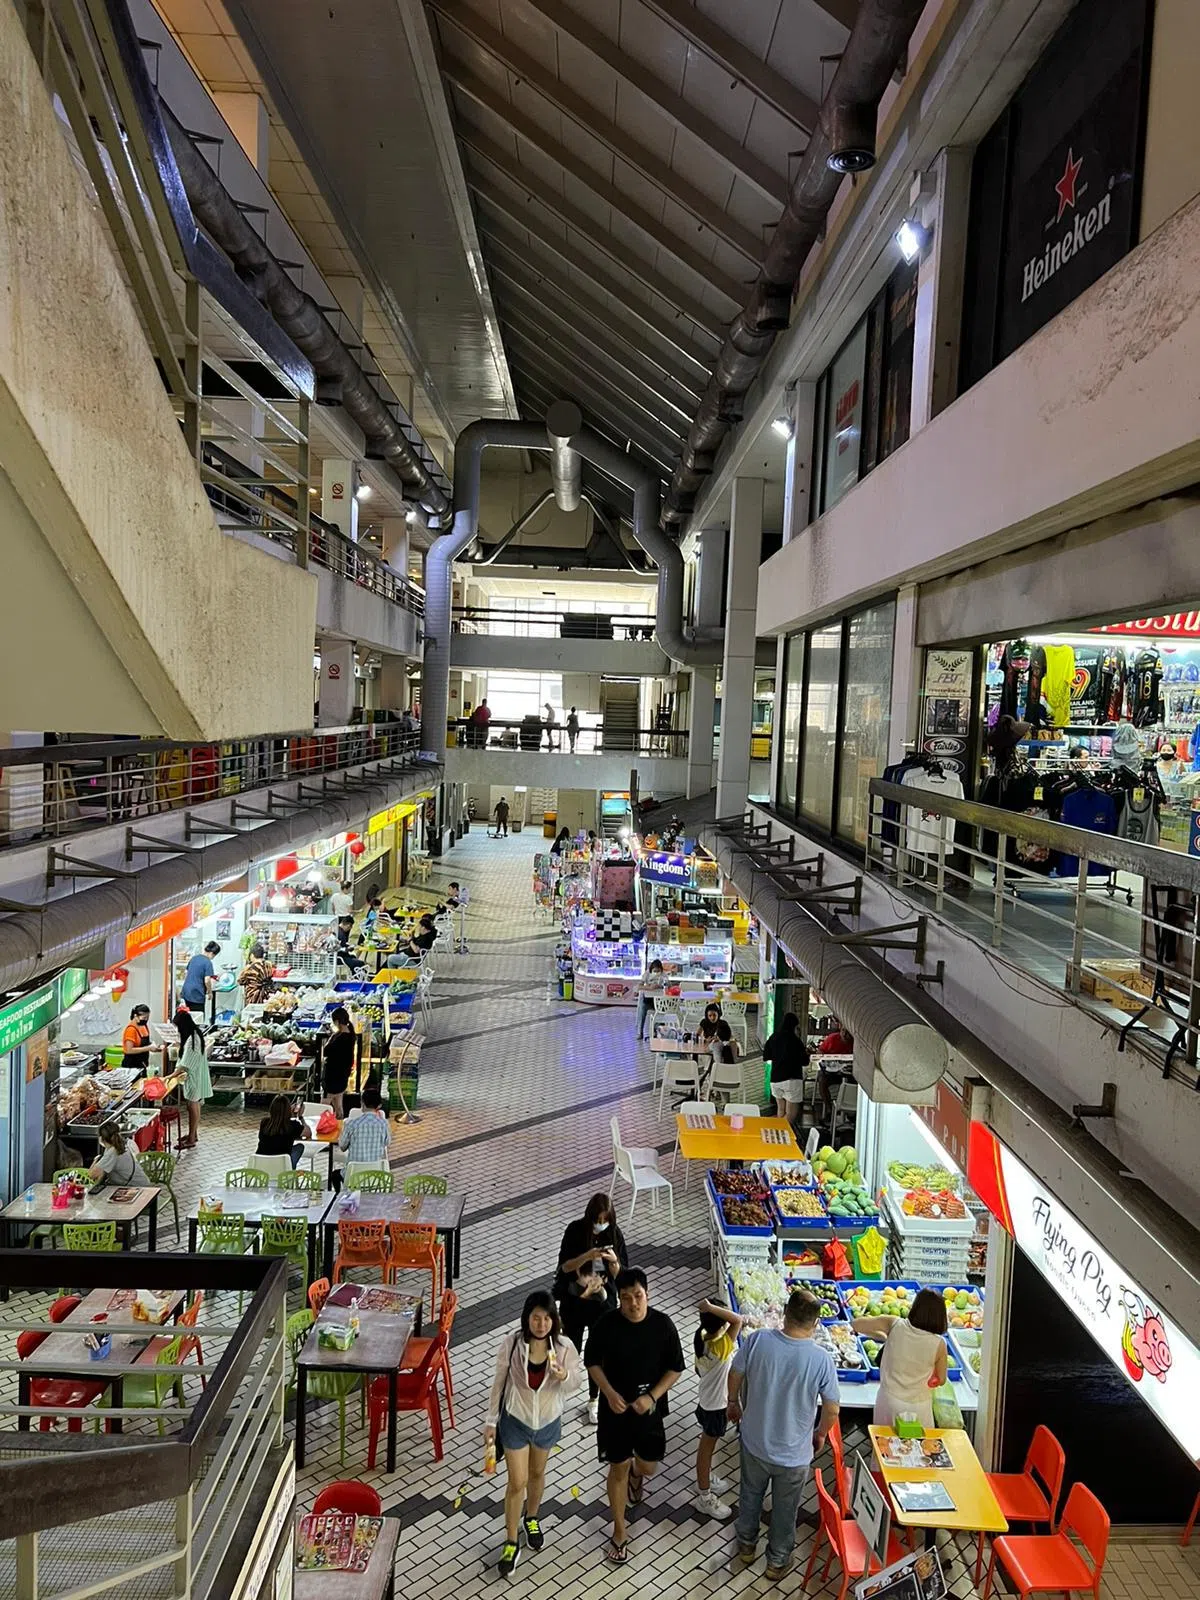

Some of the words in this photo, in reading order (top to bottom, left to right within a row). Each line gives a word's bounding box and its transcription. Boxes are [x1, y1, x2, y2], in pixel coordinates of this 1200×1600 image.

[1021, 192, 1112, 303] Heineken
[642, 857, 683, 876] Kingdom
[684, 865, 691, 876] 5
[943, 1124, 966, 1168] PUB
[1032, 1196, 1076, 1278] Flying
[1081, 1250, 1110, 1319] Pig
